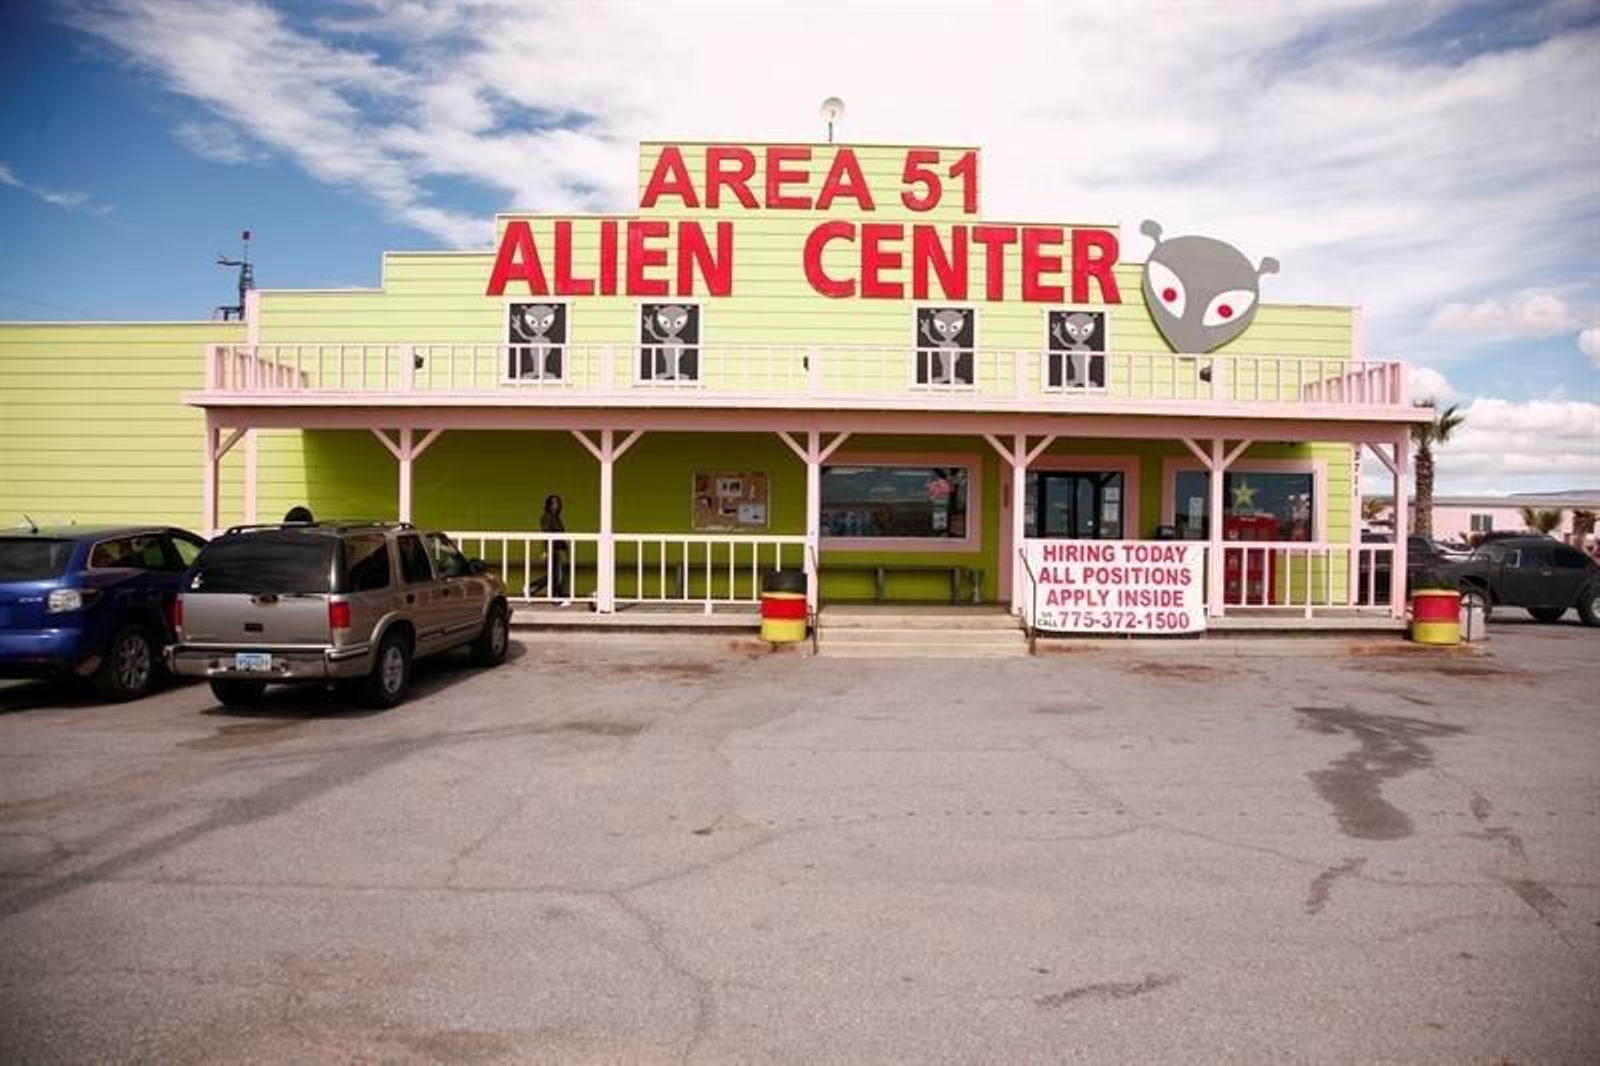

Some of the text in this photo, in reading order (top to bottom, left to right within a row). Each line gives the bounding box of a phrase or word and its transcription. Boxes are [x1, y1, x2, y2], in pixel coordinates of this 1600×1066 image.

[639, 145, 980, 214] AREA 51
[487, 219, 1121, 305] ALIEN CENTER
[1043, 544, 1188, 564] HIRING TODAY
[1038, 567, 1192, 586] ALL POSITIONS
[1046, 589, 1184, 607] APPLY INSIDE
[1058, 611, 1190, 630] 775-372-1500
